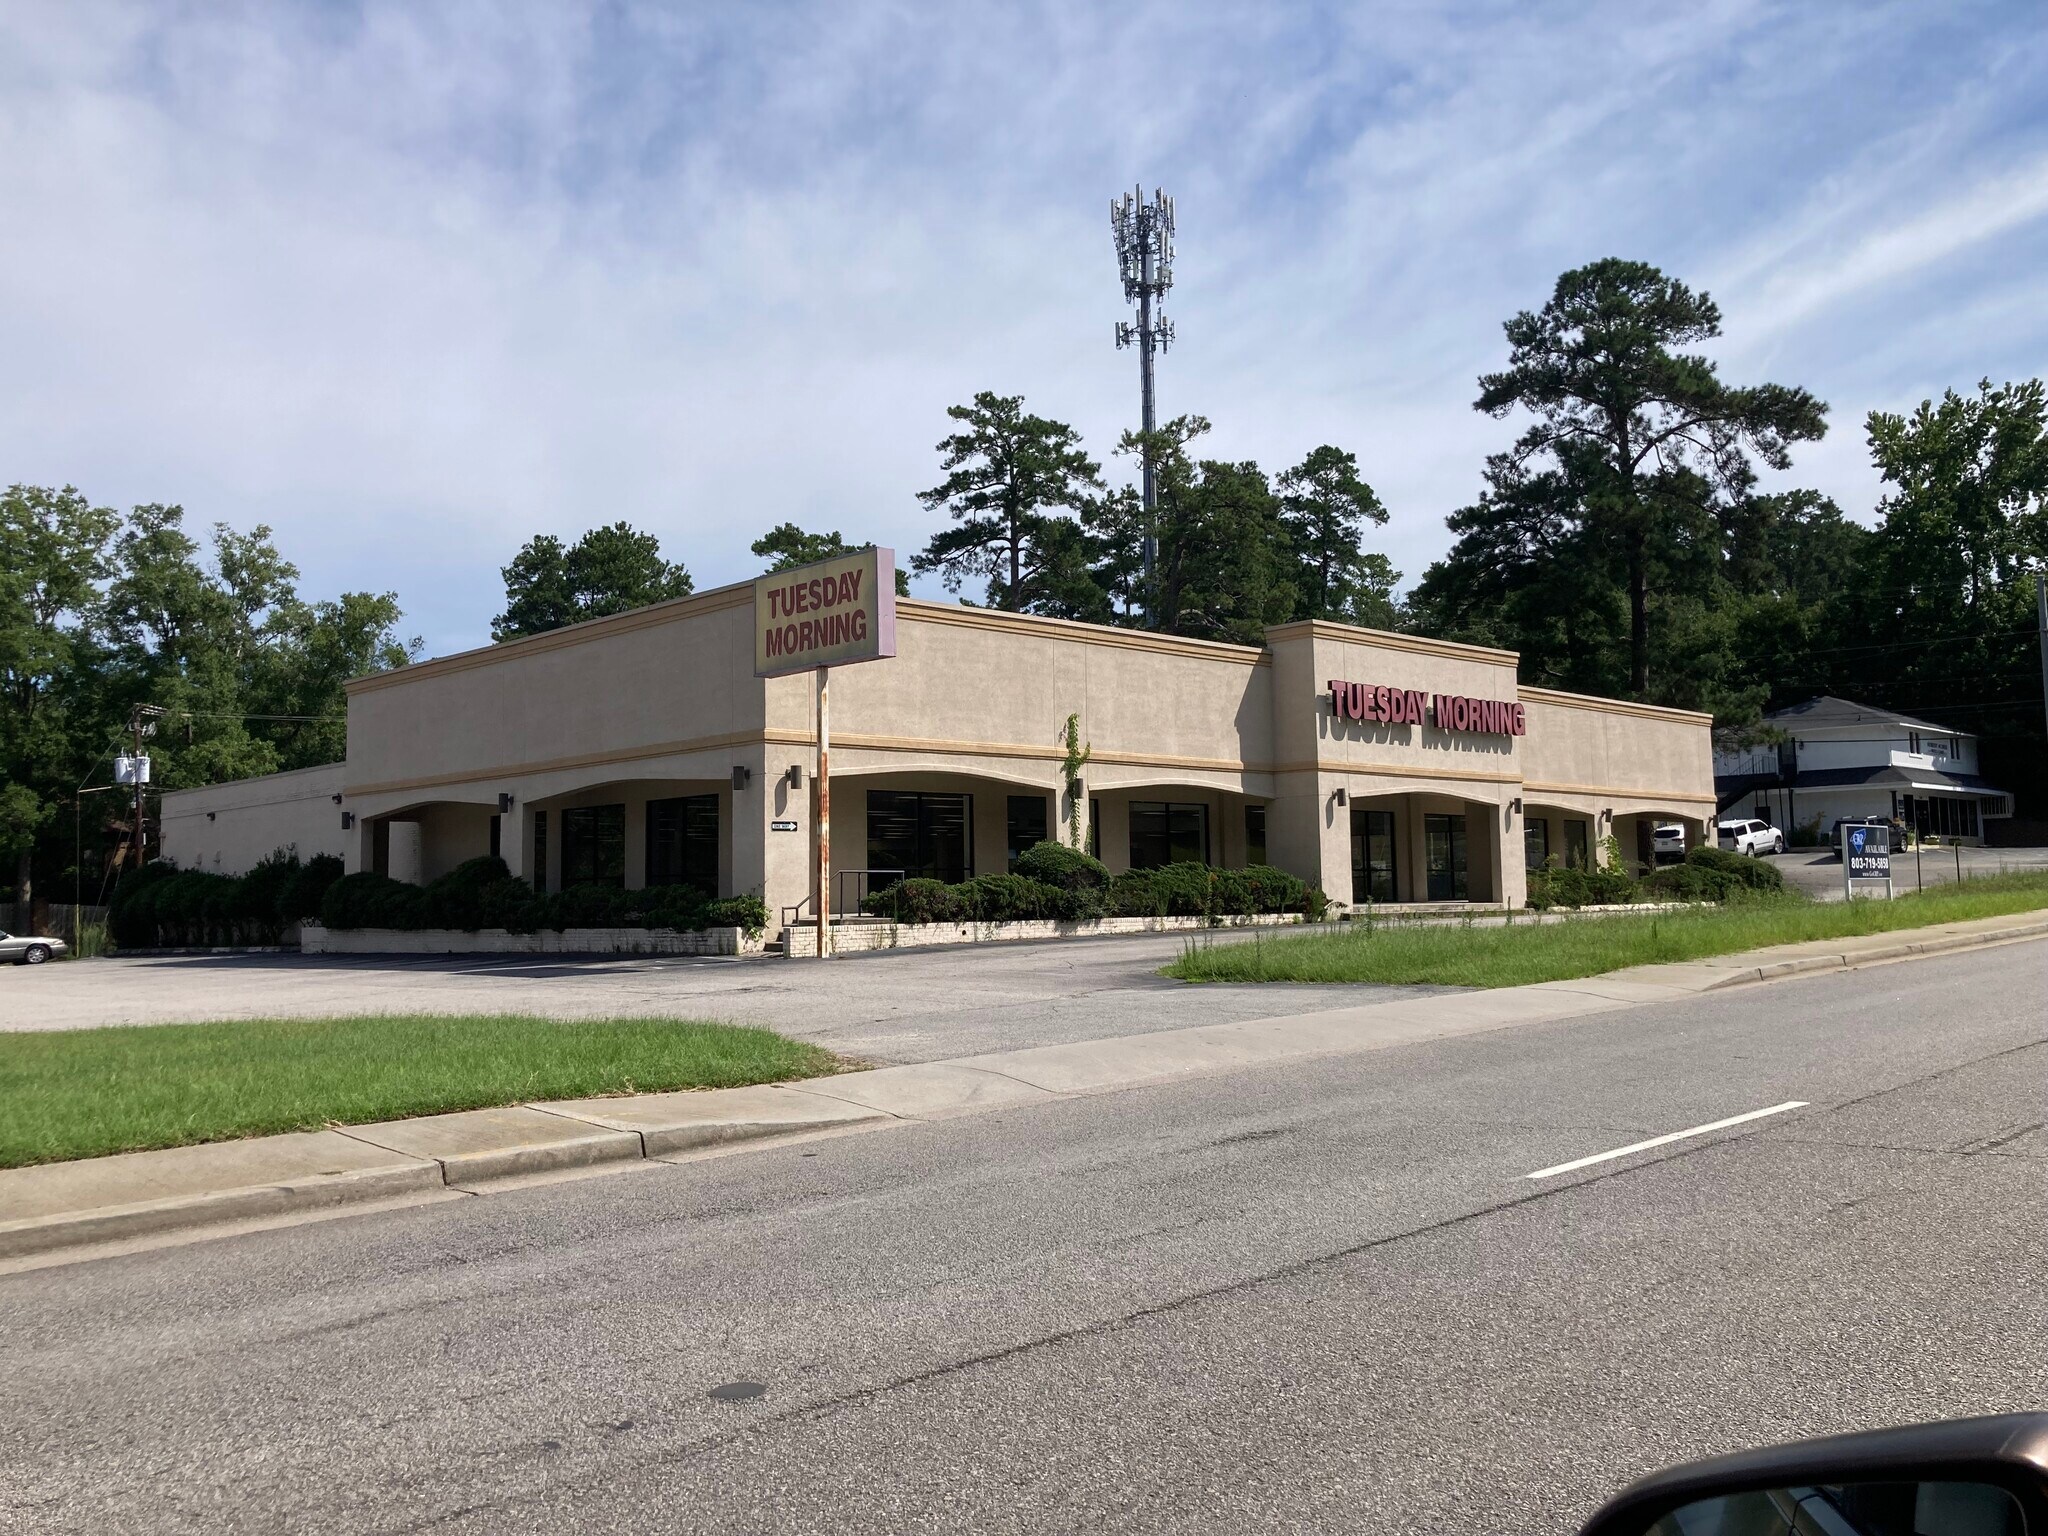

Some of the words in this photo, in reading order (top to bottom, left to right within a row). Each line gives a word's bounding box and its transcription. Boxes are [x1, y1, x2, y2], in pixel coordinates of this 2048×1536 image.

[767, 568, 863, 619] TUESDAY
[766, 608, 867, 658] MORNING
[1327, 679, 1429, 726] TUESDAY
[1432, 693, 1526, 736] MORNING
